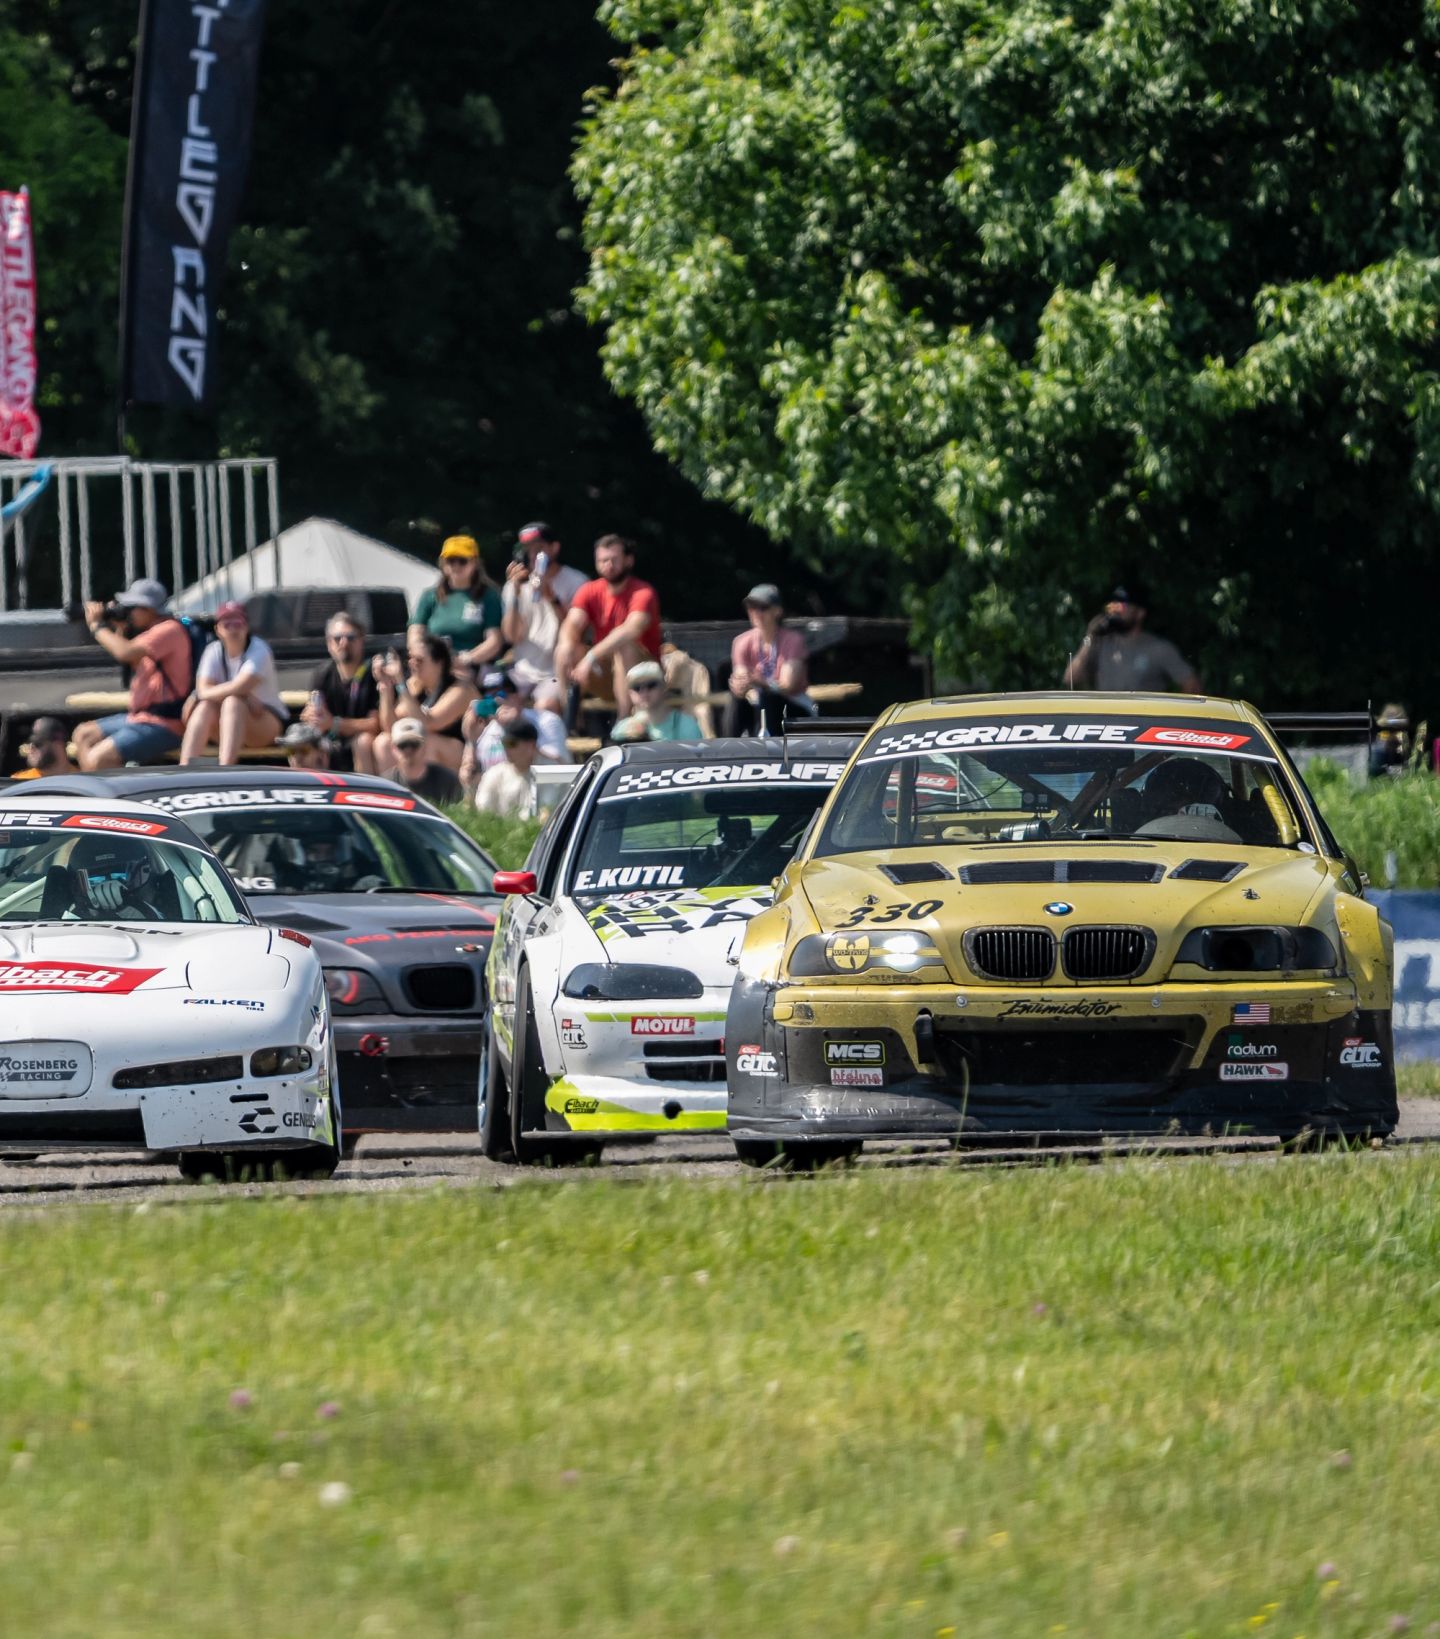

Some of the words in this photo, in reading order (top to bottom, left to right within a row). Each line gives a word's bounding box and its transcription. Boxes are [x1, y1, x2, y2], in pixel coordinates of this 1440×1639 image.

[168, 0, 226, 401] TTLEGANG
[936, 724, 1139, 746] GRIDLIFE
[171, 790, 330, 810] GRIDLIFE
[574, 866, 685, 890] E.KUTIL
[835, 900, 944, 928] 330
[183, 998, 264, 1007] FALKEN
[634, 1018, 693, 1033] MOTUL
[828, 1044, 881, 1058] MCS
[1228, 1042, 1277, 1056] radium
[1340, 1046, 1381, 1064] GLTC
[20, 1072, 61, 1080] RACING
[1224, 1064, 1265, 1076] HAWK
